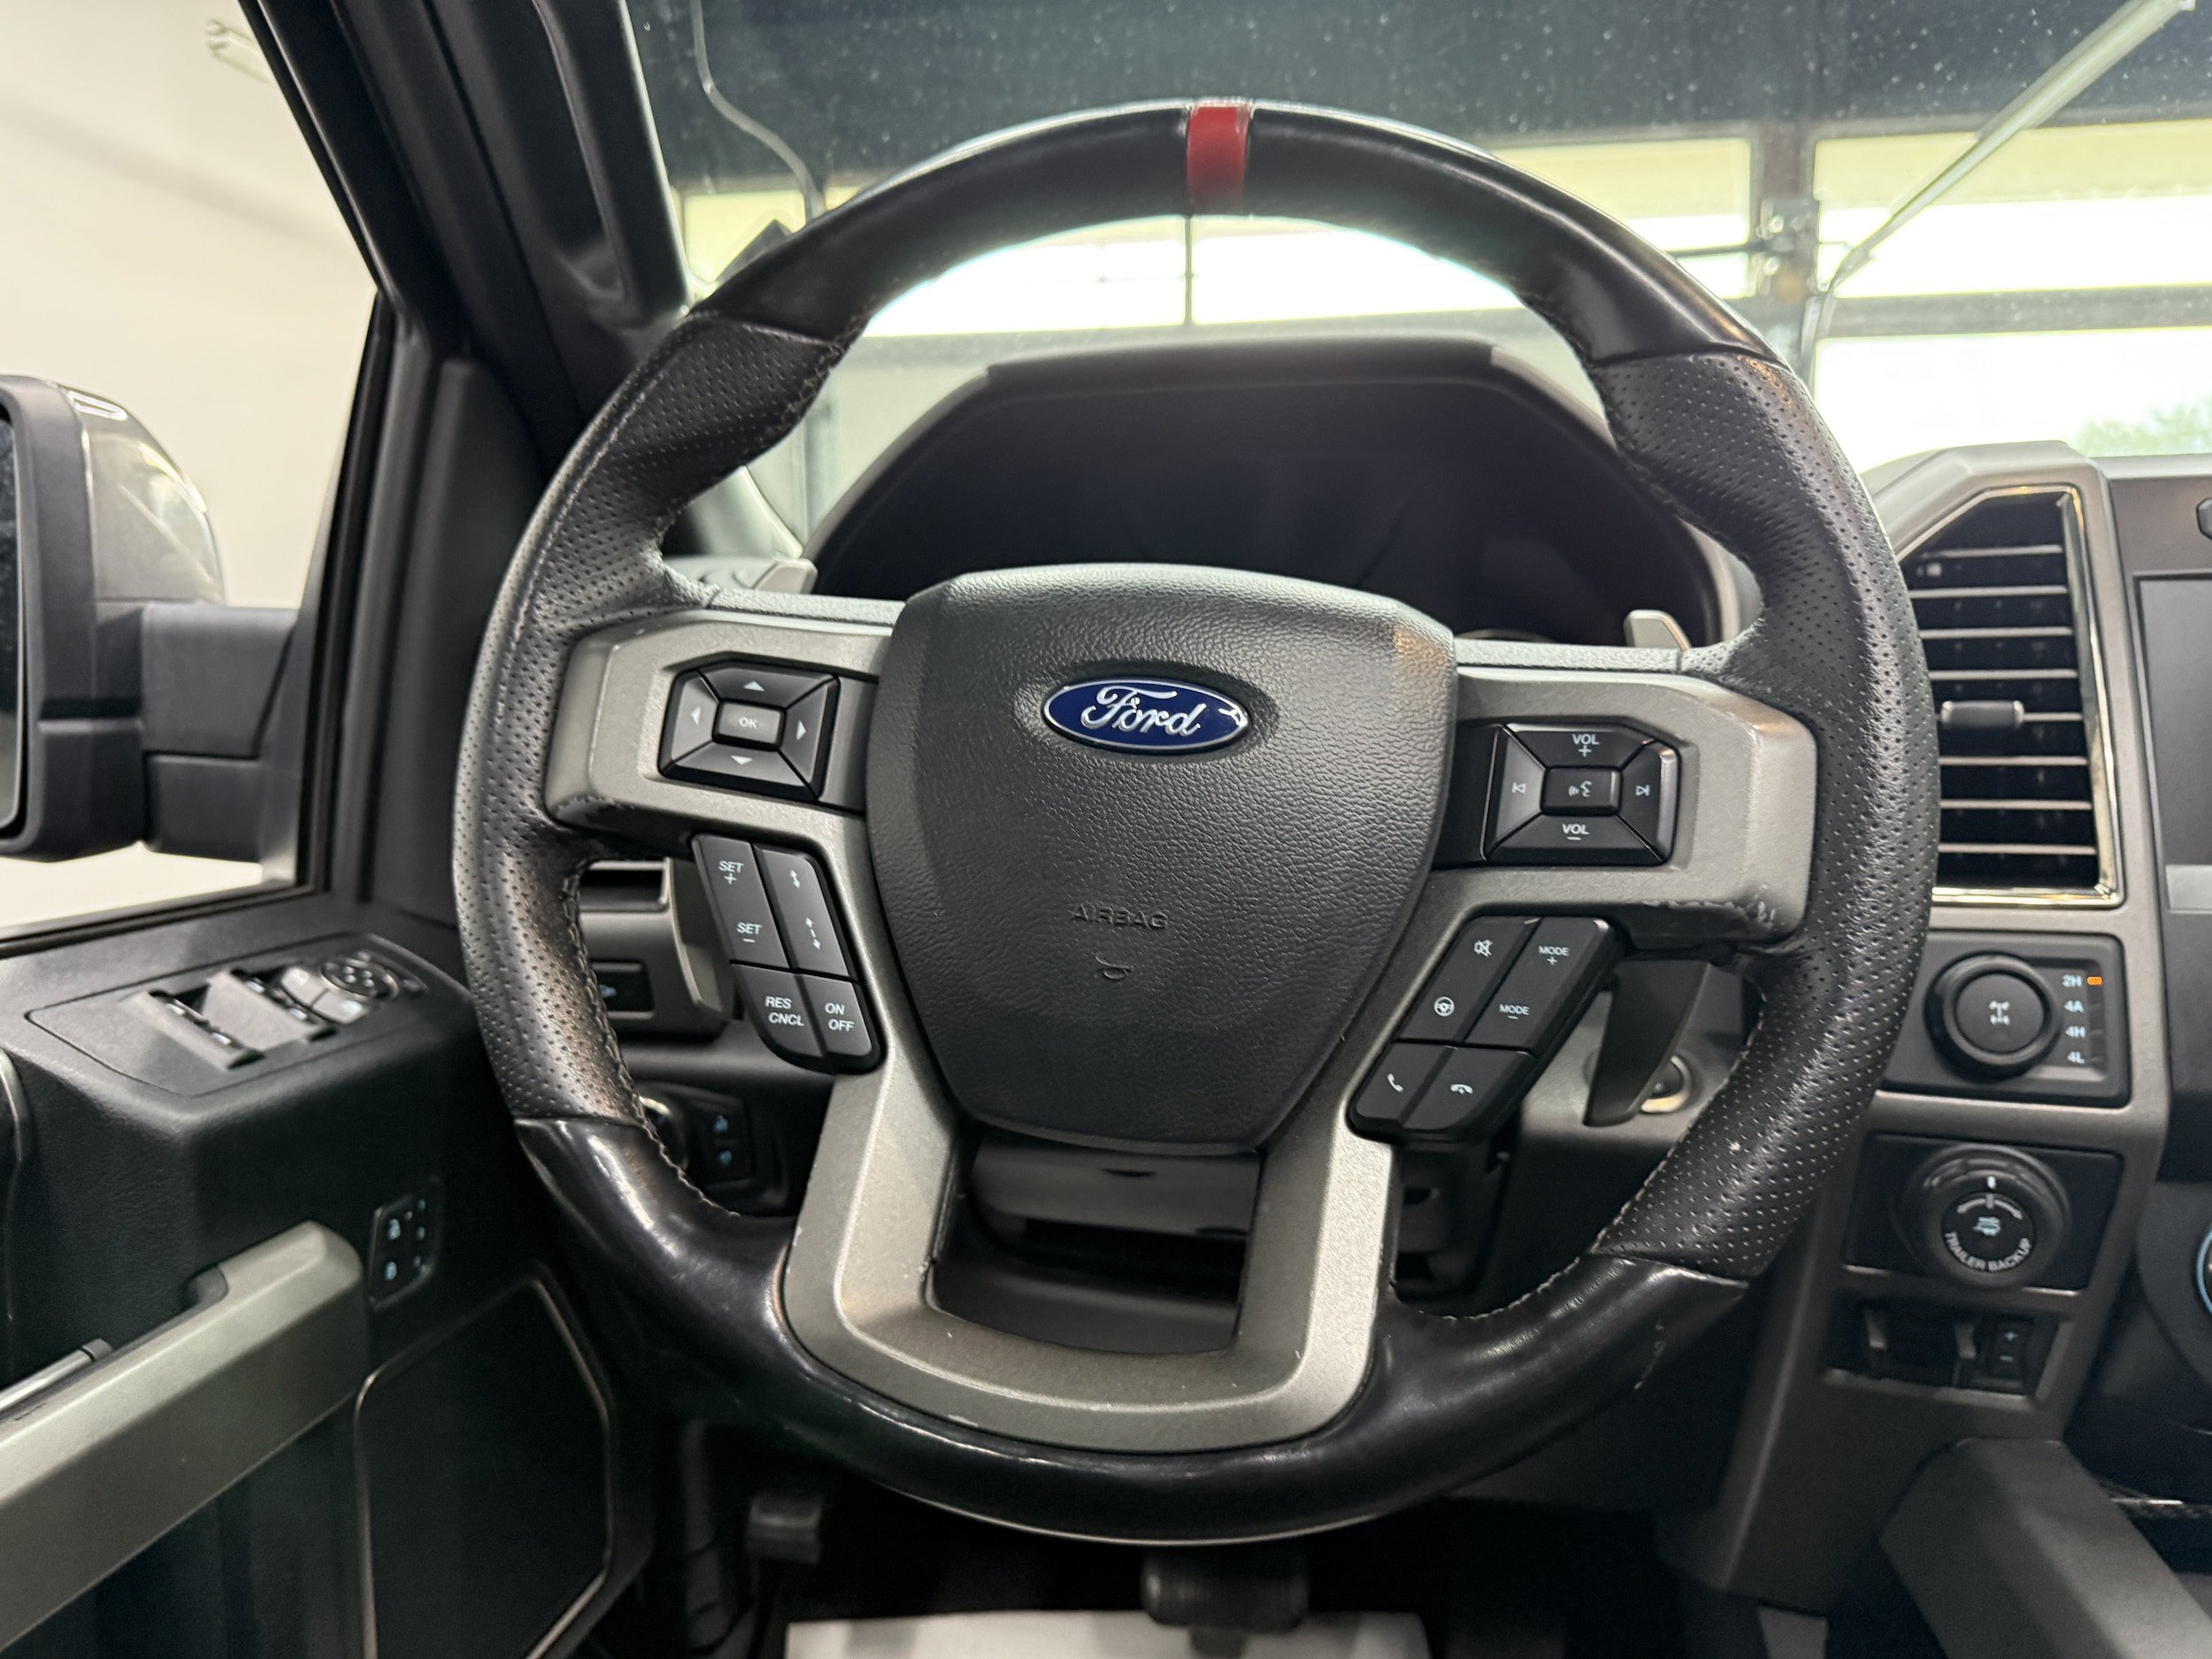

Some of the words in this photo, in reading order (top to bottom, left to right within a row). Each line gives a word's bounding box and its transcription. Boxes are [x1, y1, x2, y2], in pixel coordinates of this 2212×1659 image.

[1080, 685, 1206, 737] Ford
[739, 717, 758, 729] OK
[1572, 733, 1600, 746] VOL
[1562, 823, 1589, 835] VOL
[718, 860, 744, 874] SET
[1071, 904, 1169, 928] AIRBAG
[736, 922, 762, 936] SET
[1539, 945, 1569, 956] MODE
[2062, 974, 2083, 987] 2H
[764, 995, 792, 1010] RES
[825, 1002, 845, 1016] ON
[2063, 1000, 2084, 1013] 4A
[1499, 1004, 1530, 1016] MODE
[768, 1012, 805, 1027] CNCL
[828, 1018, 855, 1032] OFF
[2065, 1026, 2086, 1039] 4H
[2067, 1051, 2085, 1064] 4L
[1945, 1231, 1986, 1271] TRAILER
[1987, 1237, 2032, 1272] BACKUP
